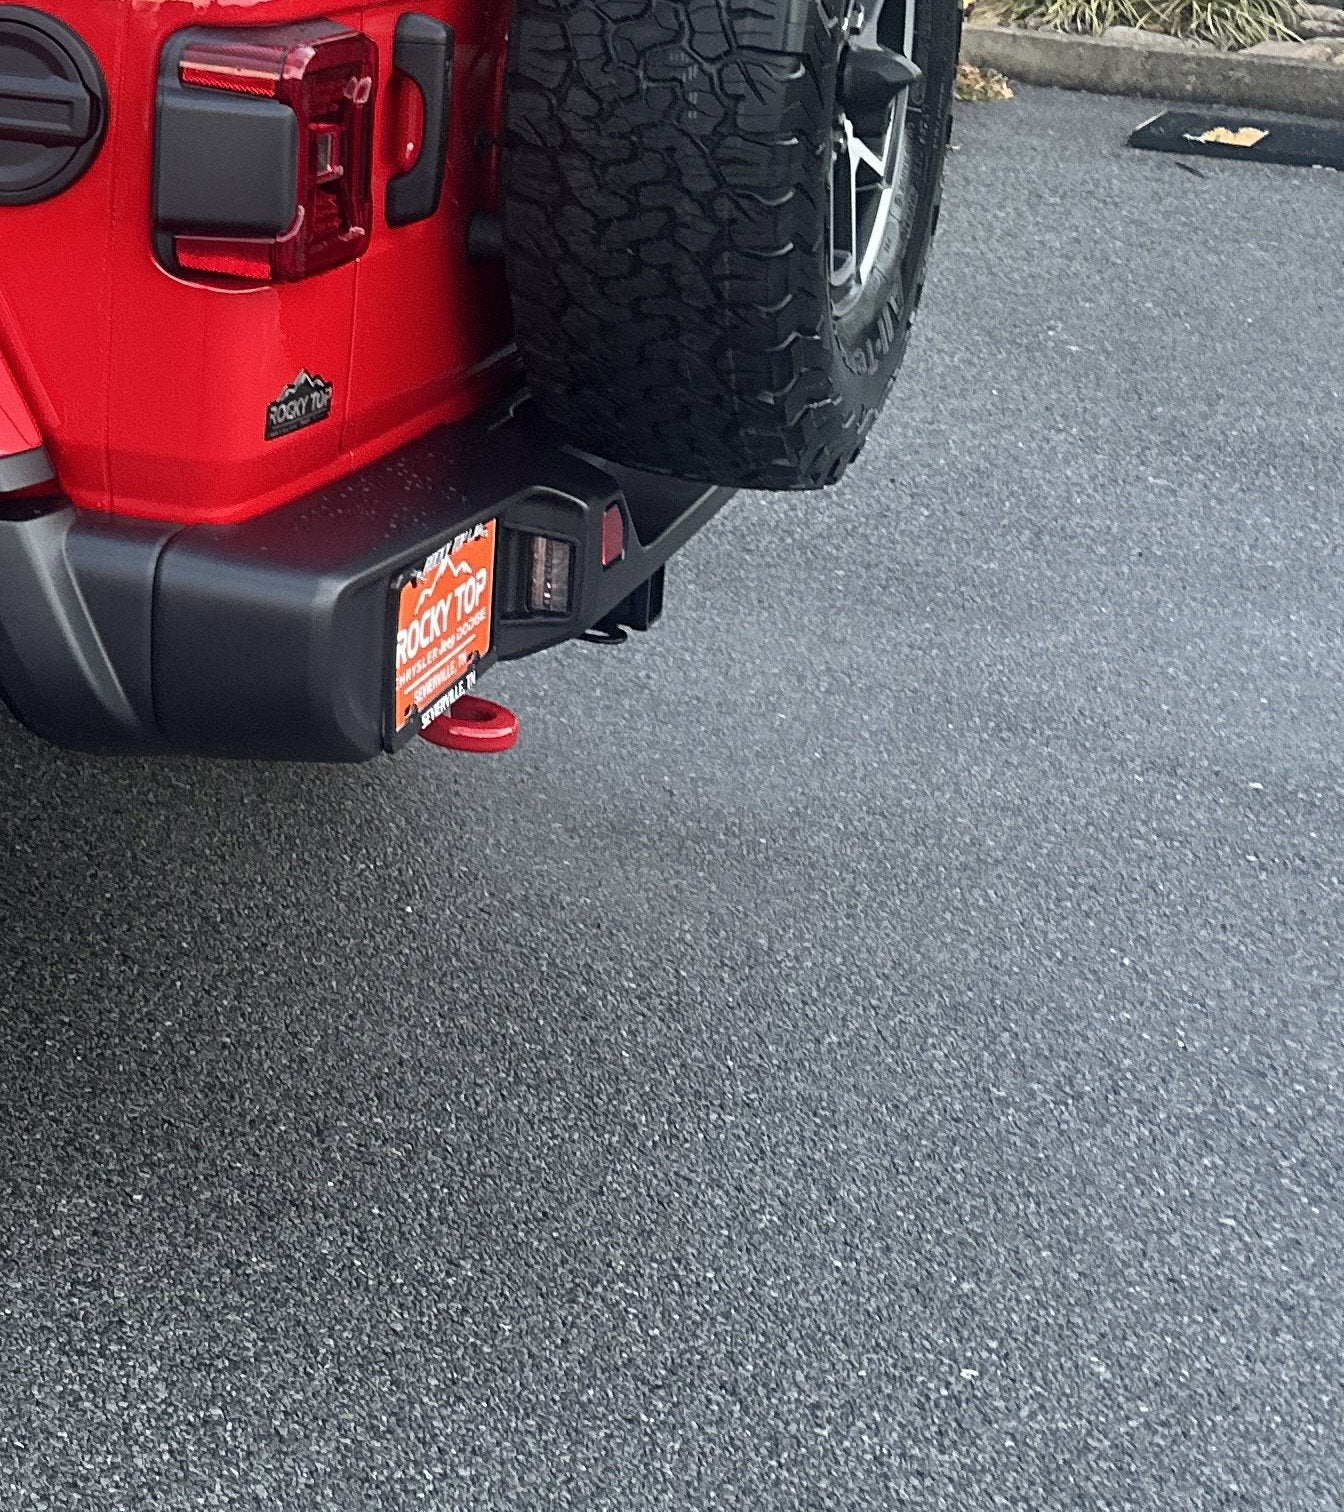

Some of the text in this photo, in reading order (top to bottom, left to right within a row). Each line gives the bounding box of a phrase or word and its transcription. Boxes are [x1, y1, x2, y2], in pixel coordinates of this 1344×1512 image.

[269, 394, 310, 425] ROCKY
[310, 386, 332, 411] TOP
[396, 567, 487, 670] ROCKY TOP
[465, 669, 477, 689] TN
